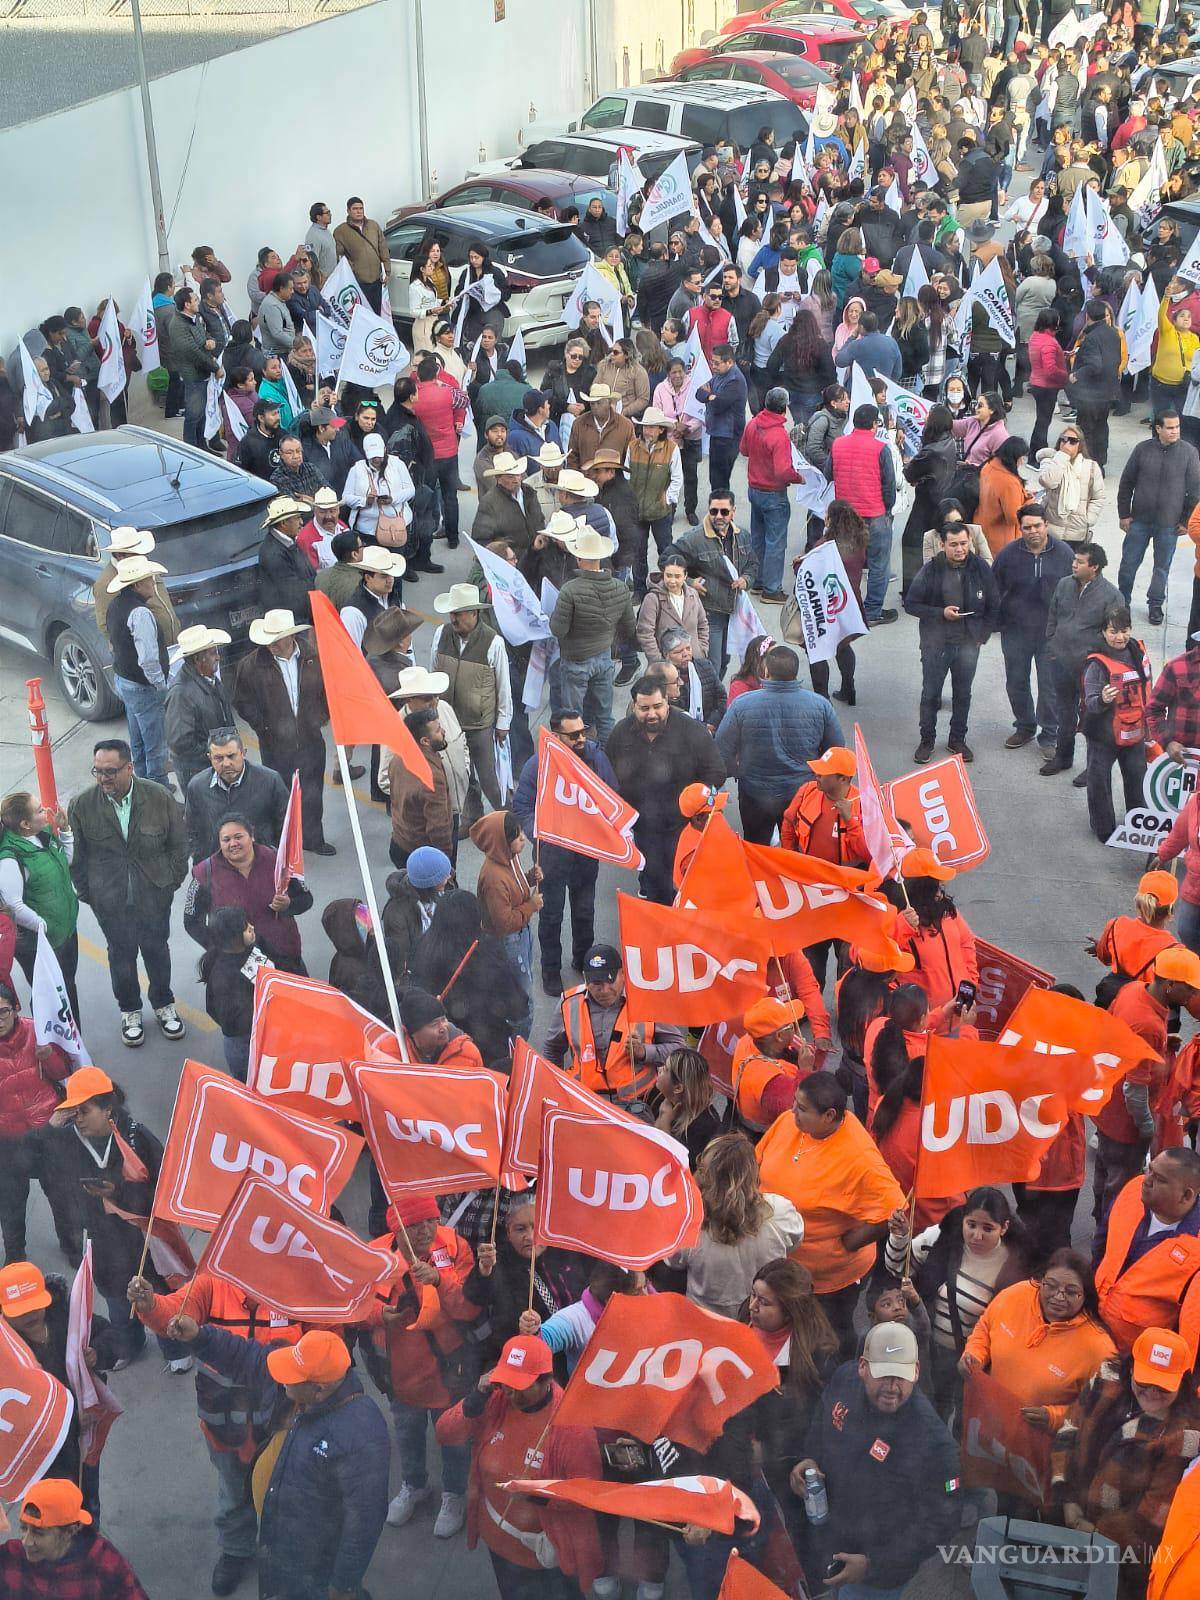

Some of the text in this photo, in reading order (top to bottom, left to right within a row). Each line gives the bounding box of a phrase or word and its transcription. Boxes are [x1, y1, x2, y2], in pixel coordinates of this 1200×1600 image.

[983, 288, 1015, 329] COAHUILA
[803, 569, 827, 638] COAHUILA
[555, 774, 600, 815] UD
[1167, 772, 1196, 796] PR
[919, 779, 957, 865] UDC
[1116, 830, 1156, 848] AQUÍ
[755, 874, 887, 920] UD
[255, 1054, 353, 1106] UD
[385, 1110, 488, 1158] UDC
[922, 1090, 1061, 1152] UDC
[209, 1132, 317, 1206] UDC
[568, 1163, 677, 1212] UDC
[584, 1338, 754, 1407] UDC
[1153, 1349, 1170, 1361] UDC
